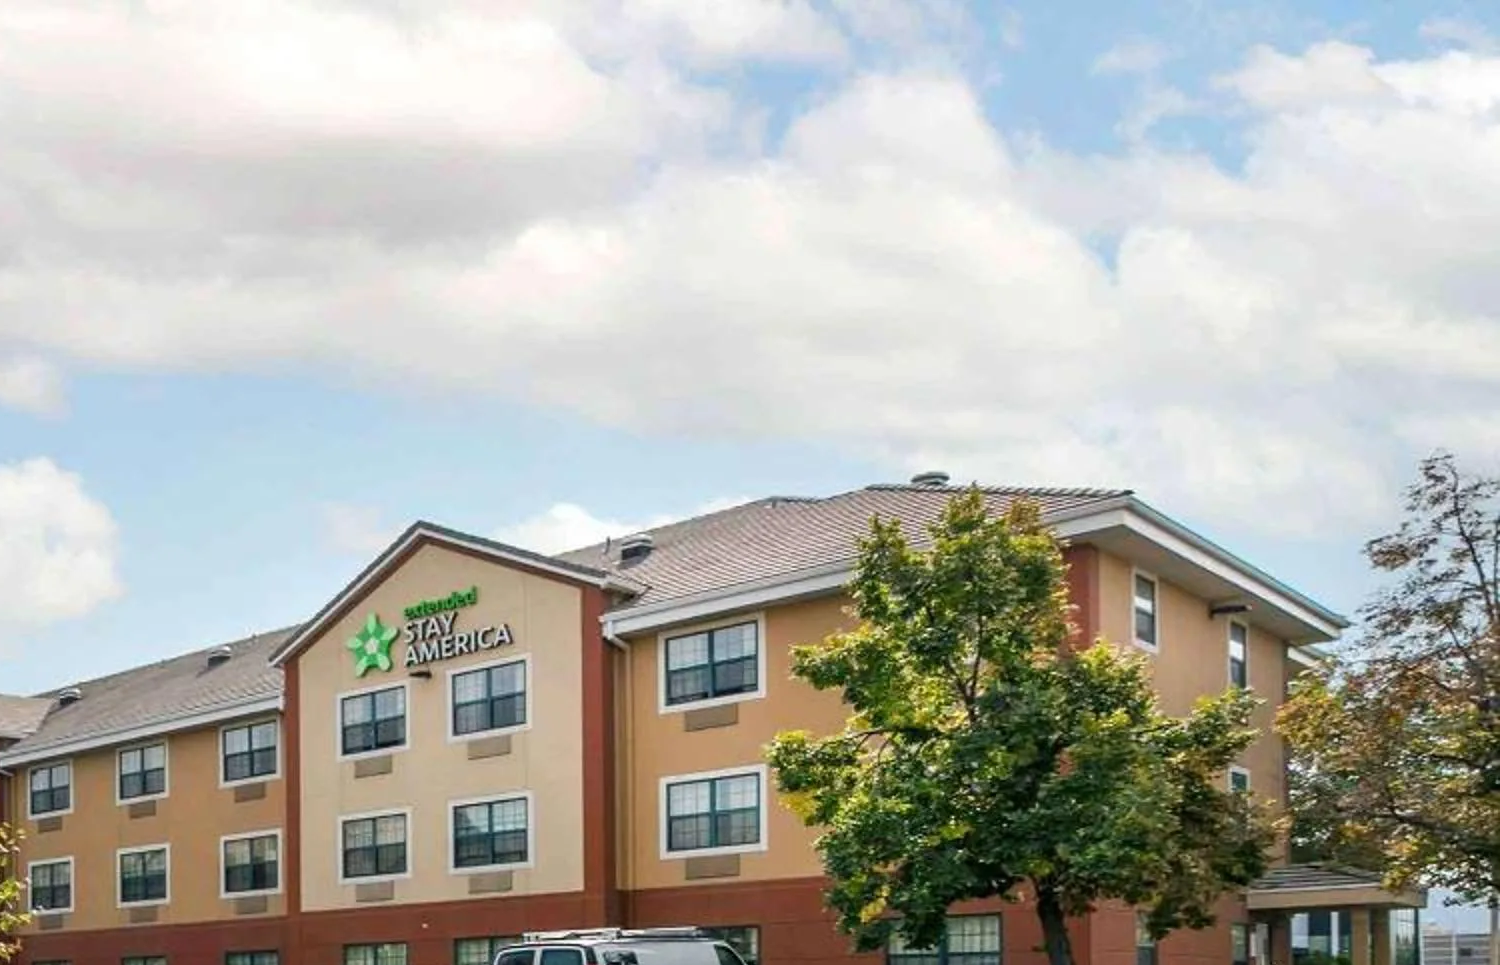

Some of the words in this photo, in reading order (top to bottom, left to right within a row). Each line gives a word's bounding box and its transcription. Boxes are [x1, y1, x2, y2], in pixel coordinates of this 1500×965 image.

[404, 585, 478, 619] extended
[404, 611, 457, 643] STAY
[405, 623, 512, 666] AMERICA
